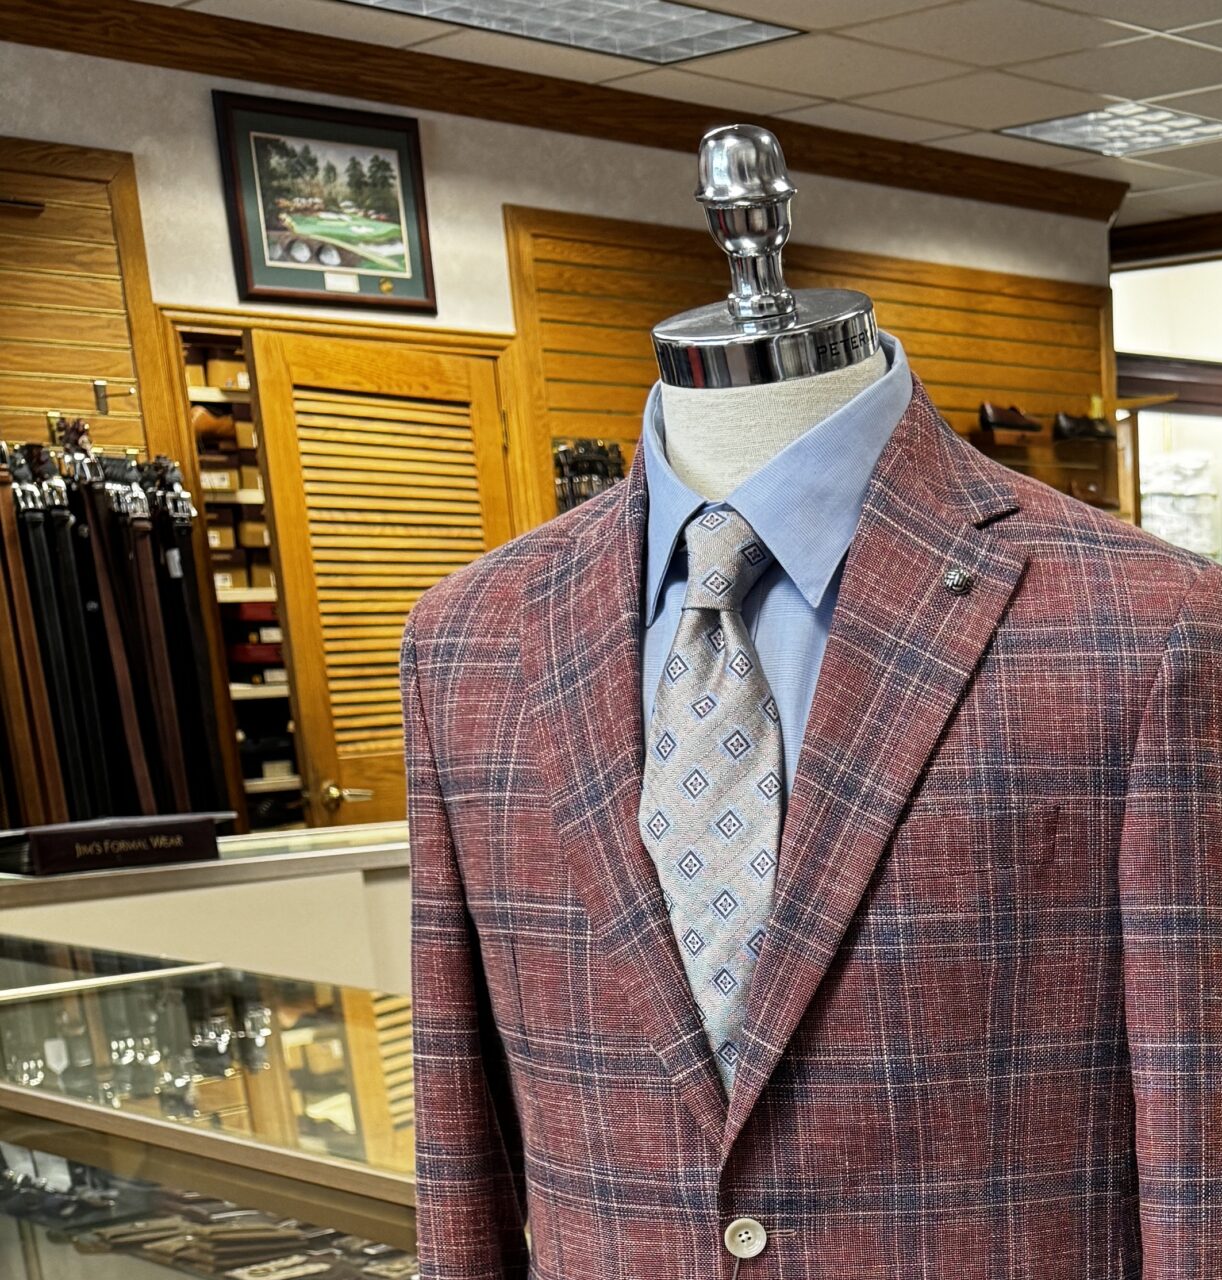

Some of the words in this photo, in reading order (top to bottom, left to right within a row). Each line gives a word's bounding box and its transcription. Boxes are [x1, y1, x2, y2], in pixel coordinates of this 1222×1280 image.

[816, 331, 866, 360] PETER
[103, 838, 149, 854] FORMAL
[149, 834, 184, 849] WEAR
